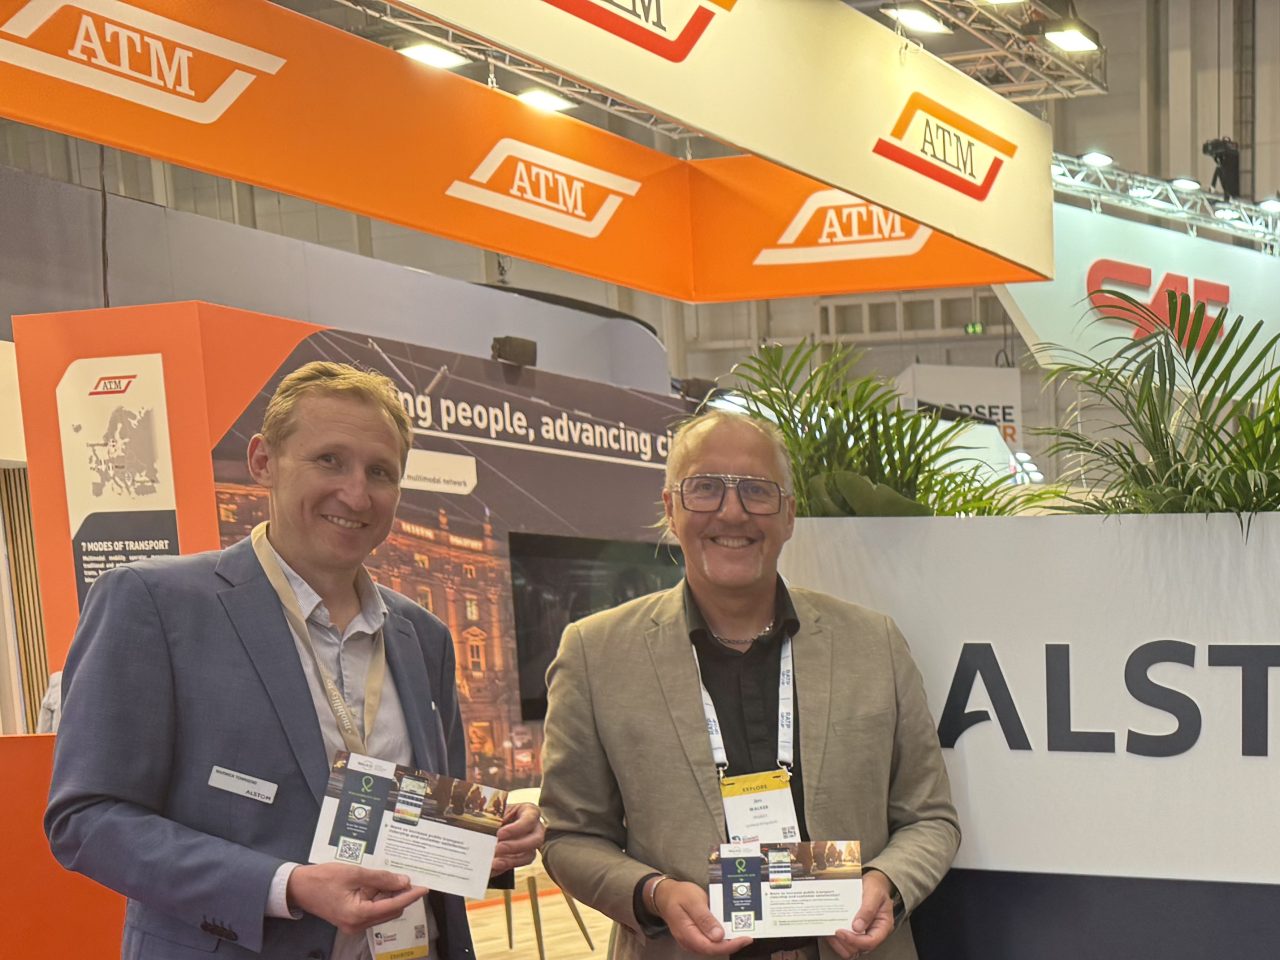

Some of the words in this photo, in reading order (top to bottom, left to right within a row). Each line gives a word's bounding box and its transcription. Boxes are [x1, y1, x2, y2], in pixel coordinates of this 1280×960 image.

[68, 14, 196, 96] ATM
[921, 118, 976, 179] ATM
[509, 160, 586, 218] ATM
[818, 204, 906, 244] ATM
[102, 380, 123, 391] ATM
[440, 398, 536, 442] people,
[540, 412, 652, 461] advancing
[656, 430, 674, 458] ci
[88, 541, 113, 552] MODES
[114, 540, 125, 551] OF
[125, 540, 170, 550] TRANSPORT
[331, 692, 352, 730] mobility
[245, 790, 271, 801] ALSTOM
